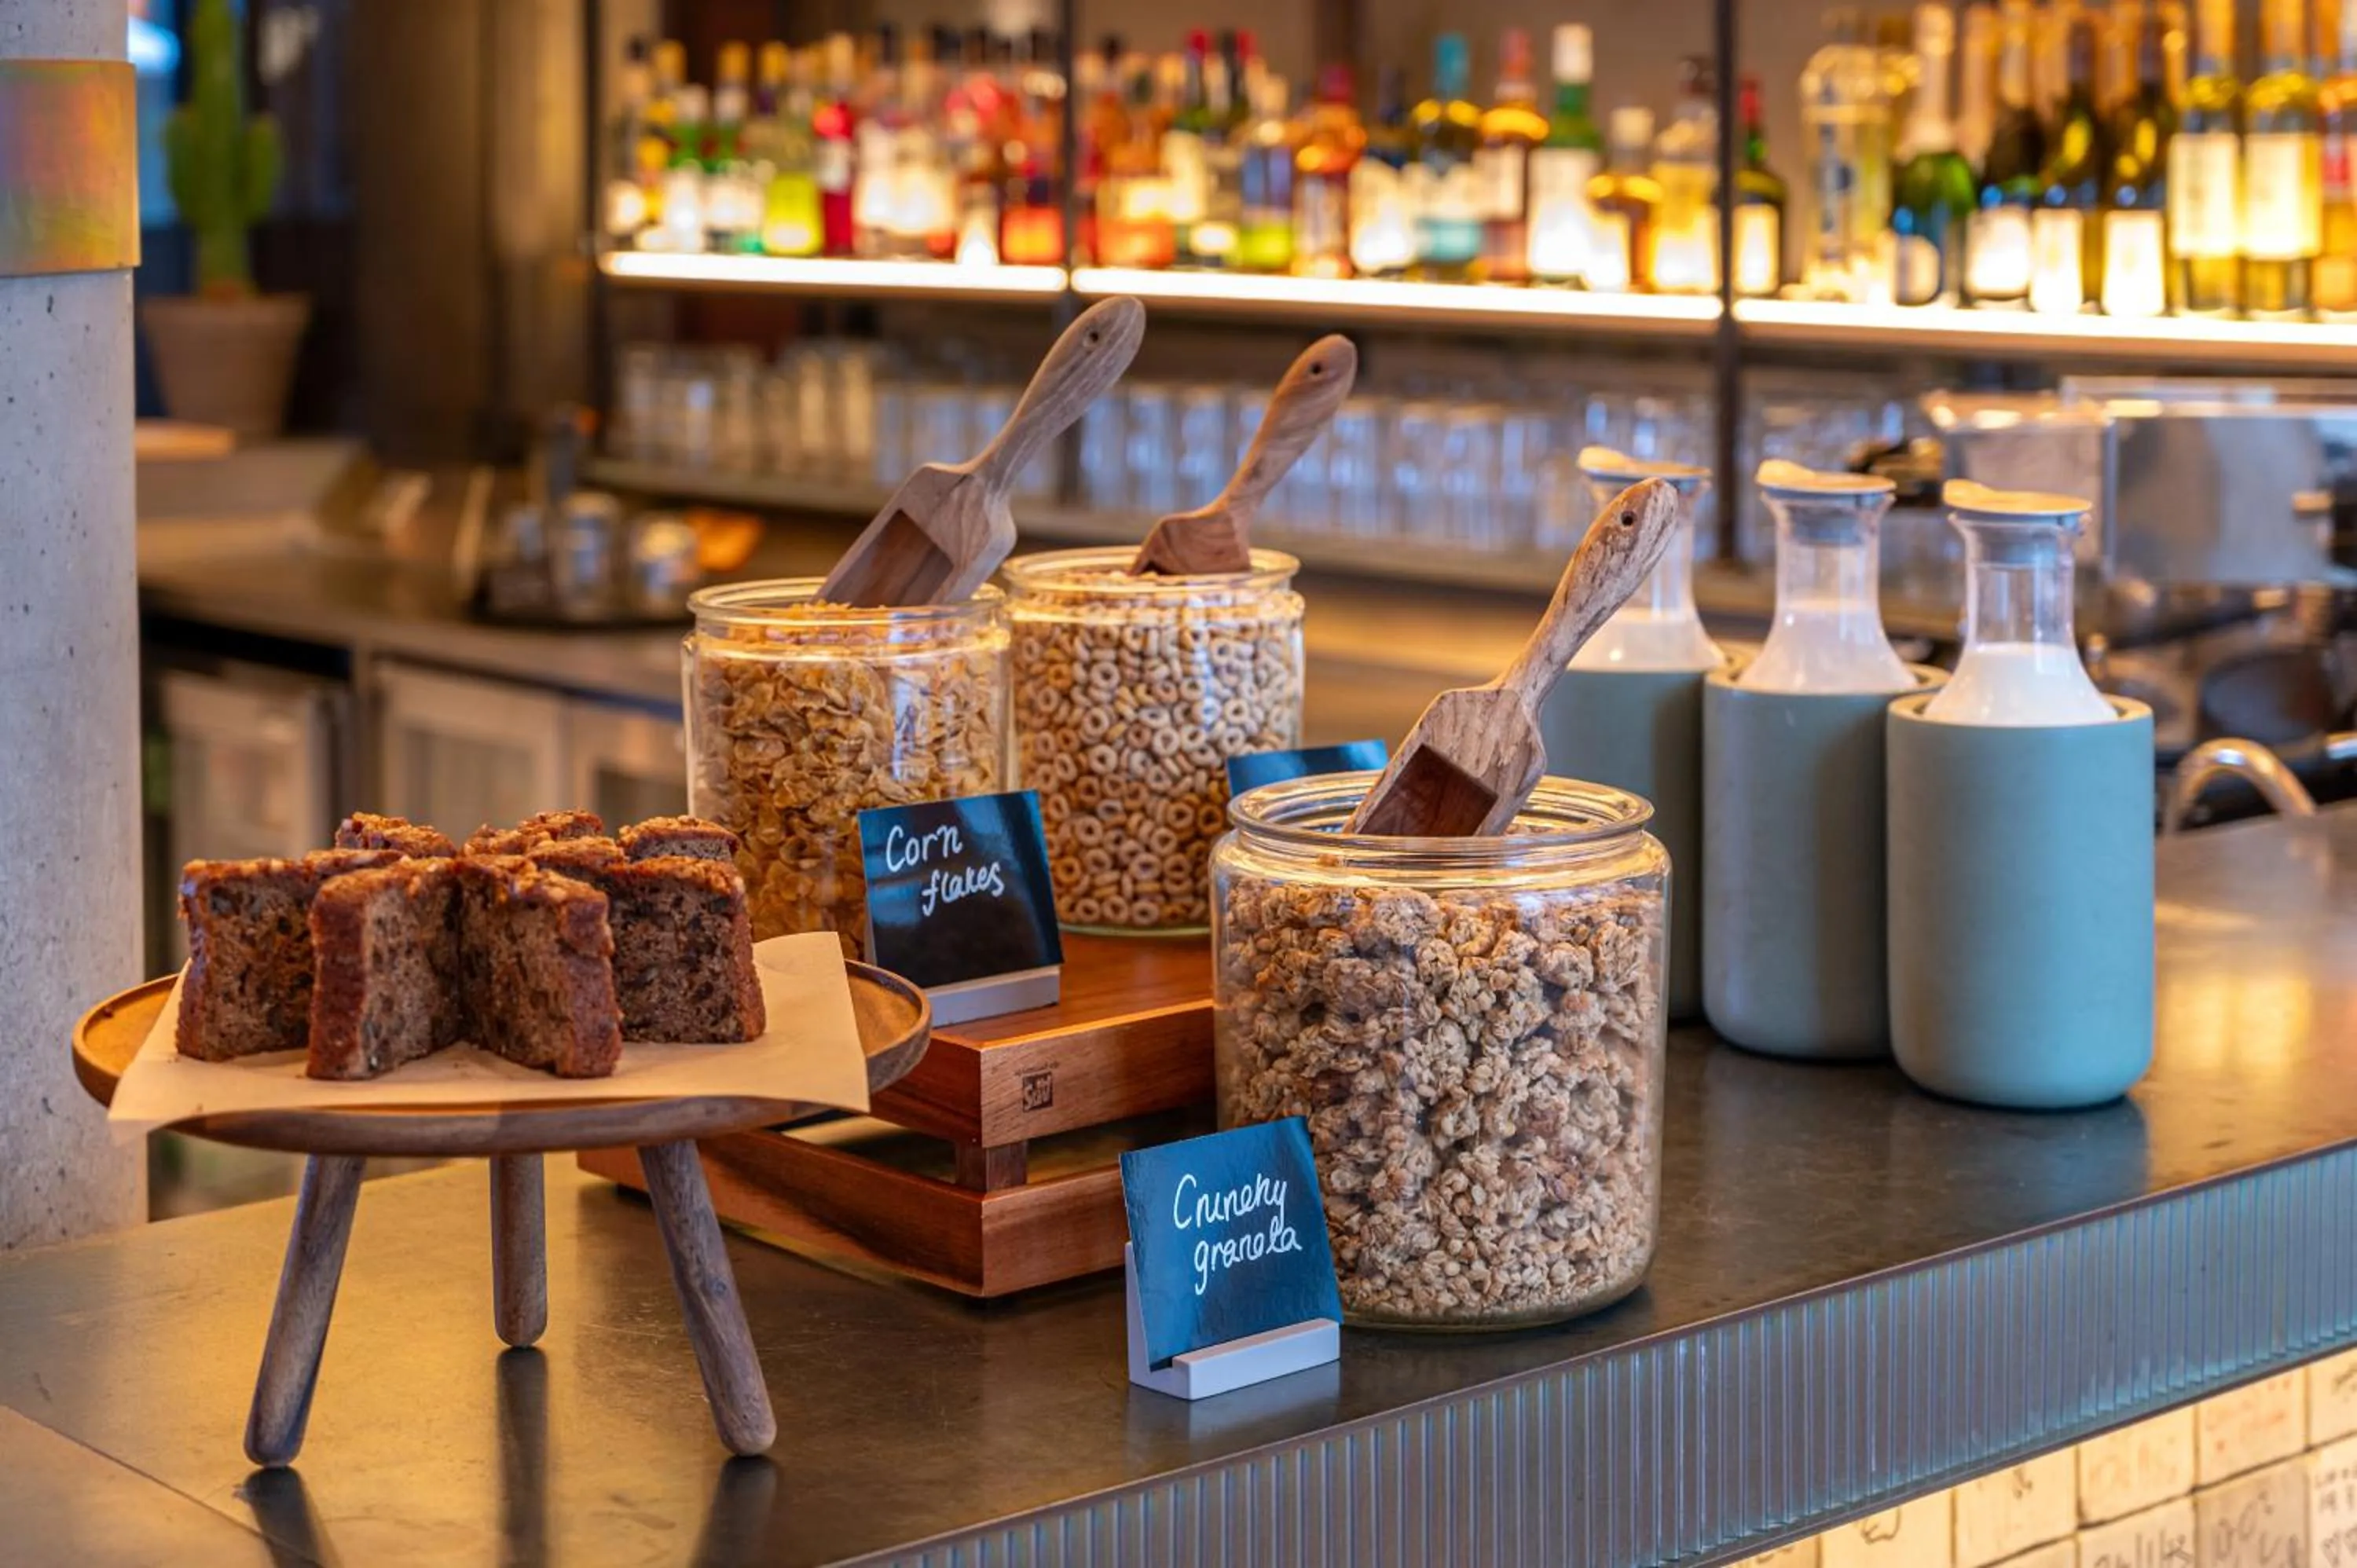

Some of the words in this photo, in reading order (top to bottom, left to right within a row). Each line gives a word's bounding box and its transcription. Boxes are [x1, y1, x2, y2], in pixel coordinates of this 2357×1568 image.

[886, 826, 962, 872] Corn
[922, 863, 1004, 917] flakes
[1174, 1174, 1287, 1229] Crunchy
[1194, 1216, 1302, 1295] granola
